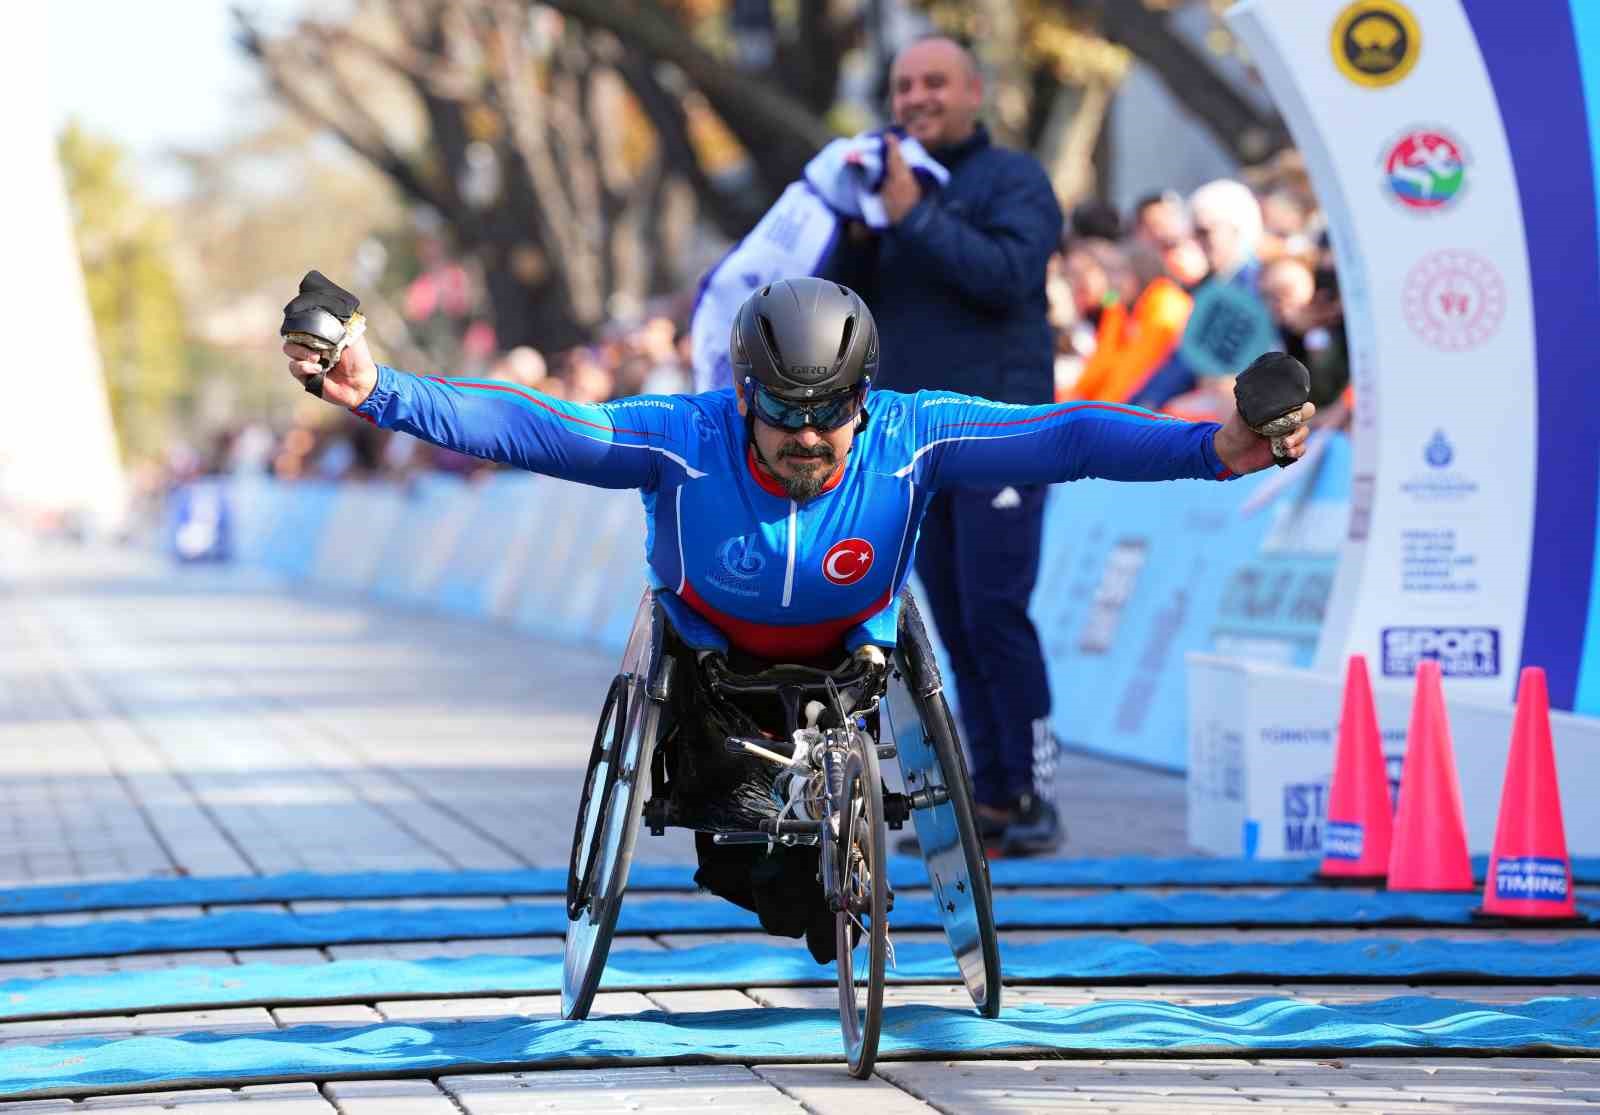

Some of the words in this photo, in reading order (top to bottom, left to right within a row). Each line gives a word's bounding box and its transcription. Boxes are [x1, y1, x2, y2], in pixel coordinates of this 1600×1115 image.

[791, 366, 827, 376] GIRO
[1387, 629, 1494, 657] SPOR
[1497, 875, 1566, 894] TIMING
